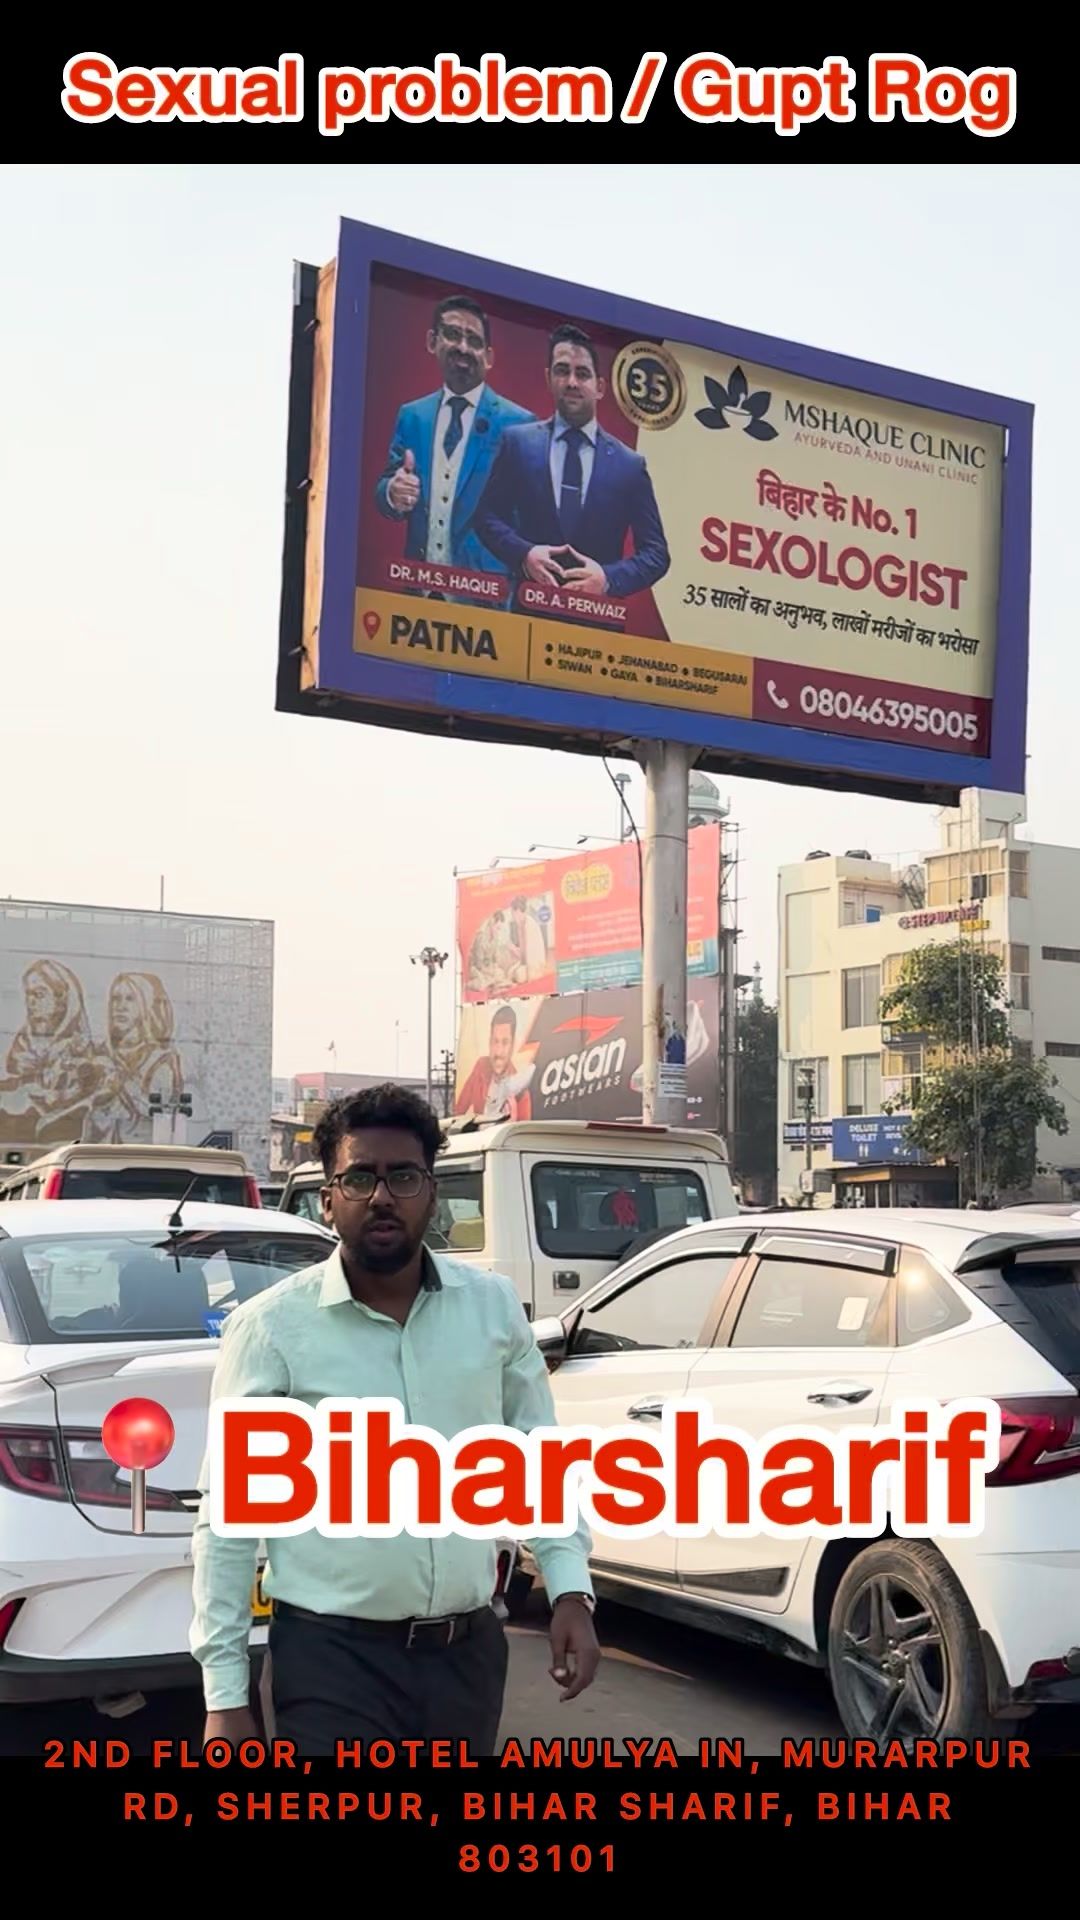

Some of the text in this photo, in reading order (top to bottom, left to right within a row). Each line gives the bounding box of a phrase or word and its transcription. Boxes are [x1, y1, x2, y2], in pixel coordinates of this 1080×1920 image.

[631, 368, 668, 403] 35
[784, 400, 986, 469] MSHAQUE CLINIC
[794, 432, 978, 485] AYURVEDA AND UNANI CLINIC
[756, 468, 917, 540] बिहार के No. 1
[390, 564, 499, 597] DR. M.S. HAQUE
[700, 516, 968, 611] SEXOLOGIST
[525, 588, 627, 621] DR. A. PERWAIZ
[683, 583, 980, 656] 35 सालों का अनुभव, लाखों मरीजों का भरोसा
[391, 614, 499, 662] PATNA
[558, 643, 748, 686] HAJIPUR JEHANABAD BEGUSARAI
[558, 658, 719, 696] SIWAN GAYA BIHARSHARIF
[800, 685, 978, 742] 08046395005
[541, 1037, 627, 1096] asian
